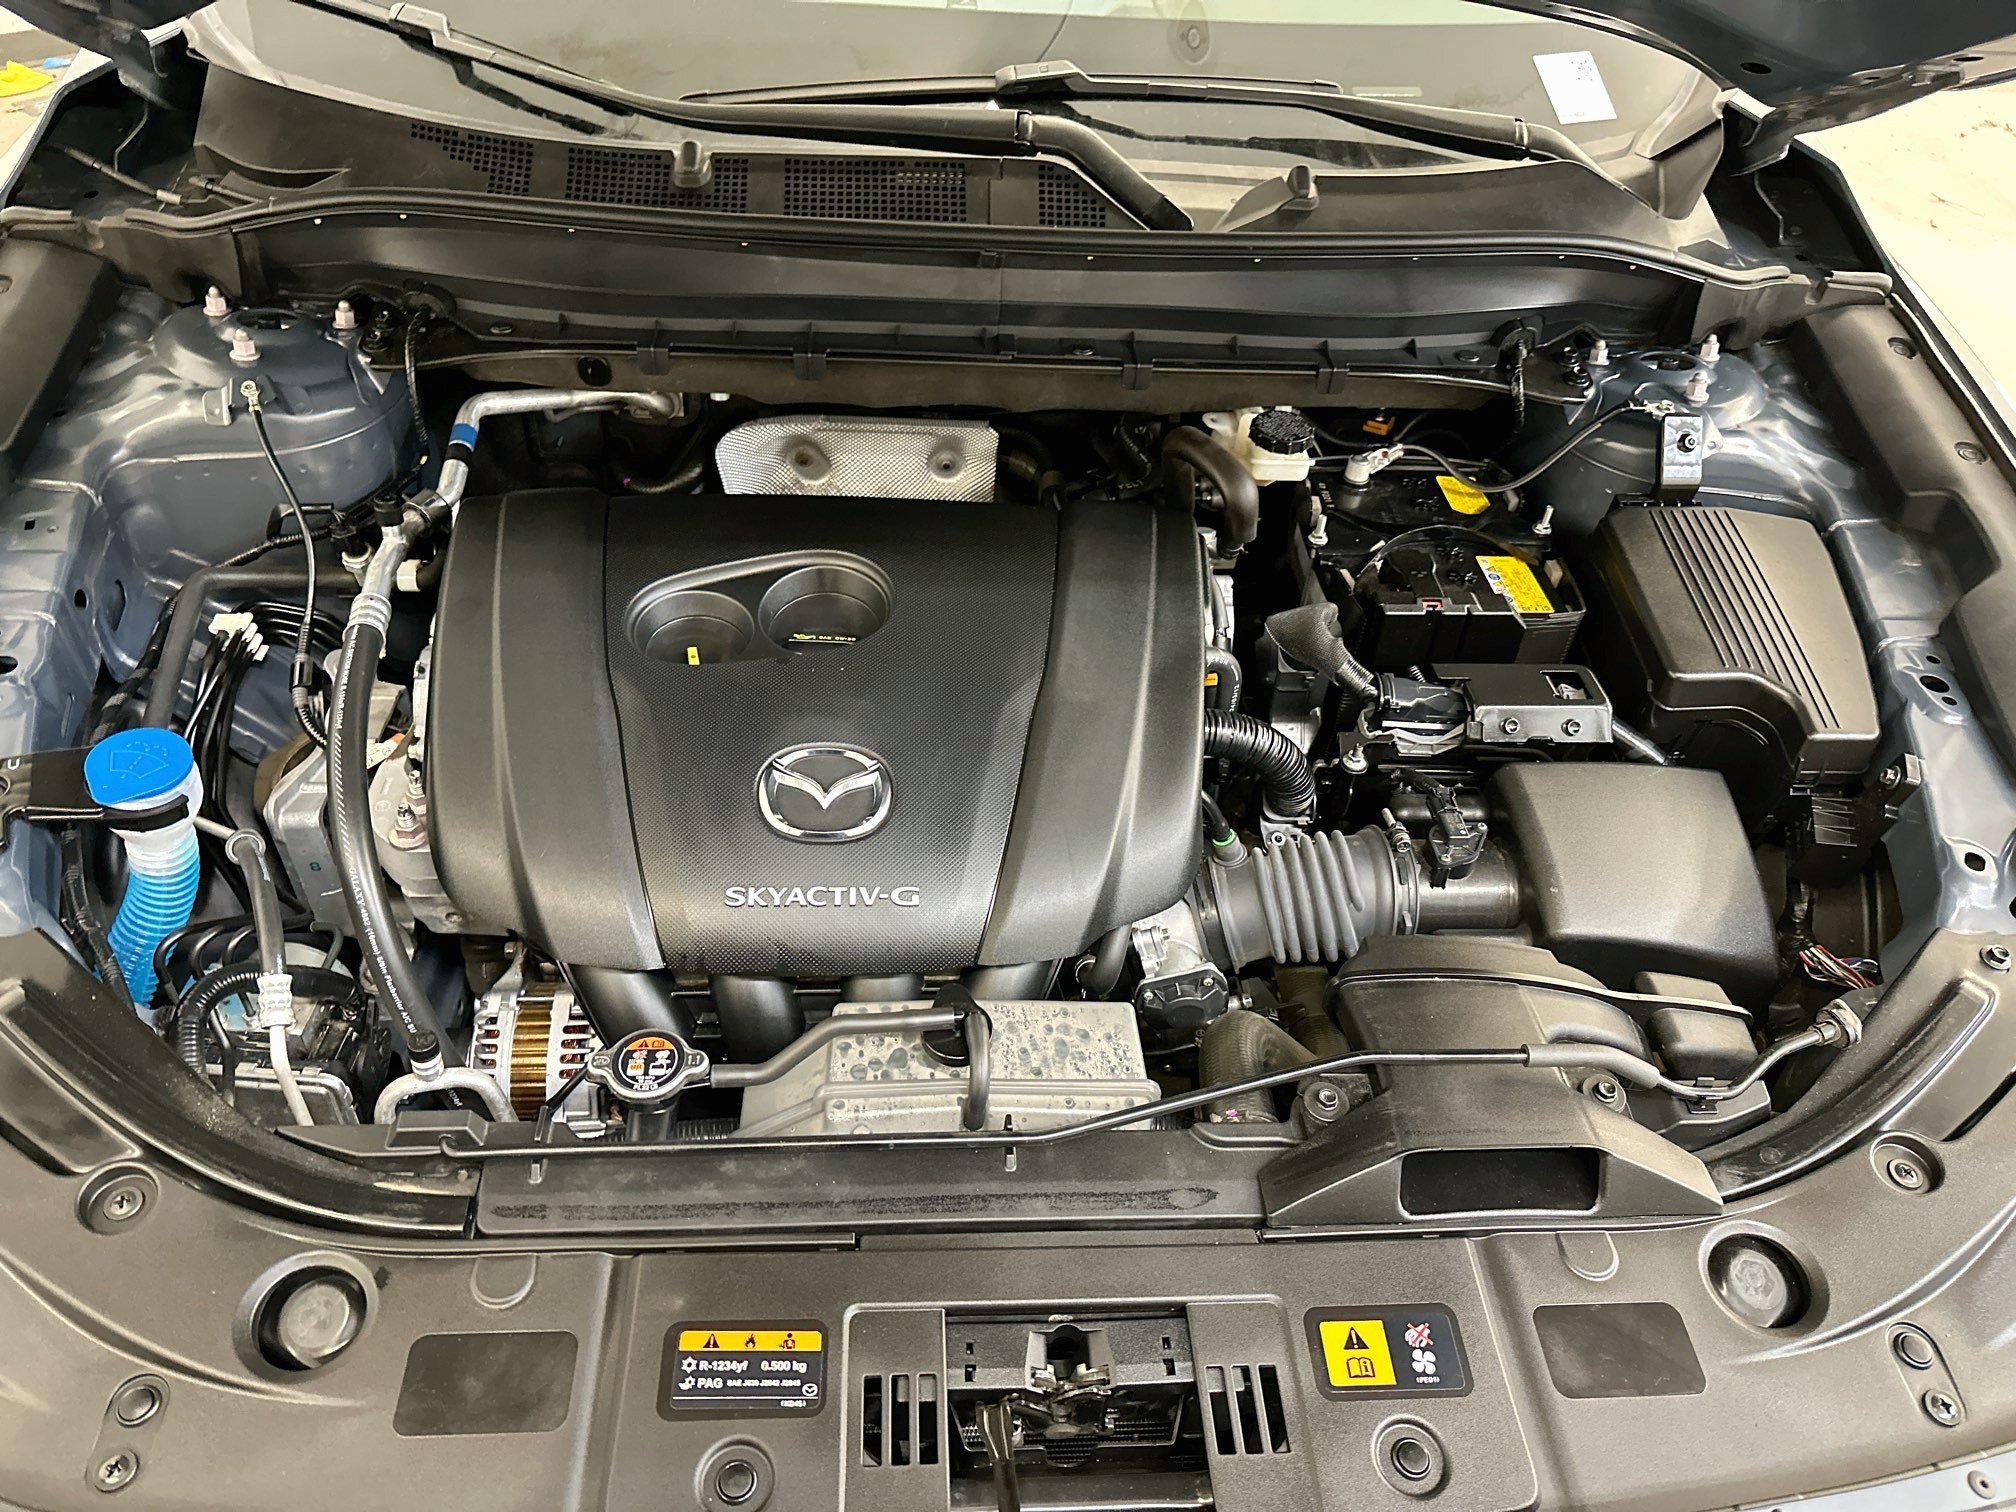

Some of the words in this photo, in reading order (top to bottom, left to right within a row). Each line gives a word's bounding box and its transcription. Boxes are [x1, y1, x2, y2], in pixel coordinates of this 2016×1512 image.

[348, 866, 366, 907] GALAXY
[724, 886, 920, 907] SKYACTIV-G
[687, 1055, 701, 1065] 1.1
[698, 1360, 749, 1373] R-1234yf
[760, 1360, 792, 1372] 0.500
[793, 1360, 808, 1374] kg
[697, 1377, 724, 1389] PAG
